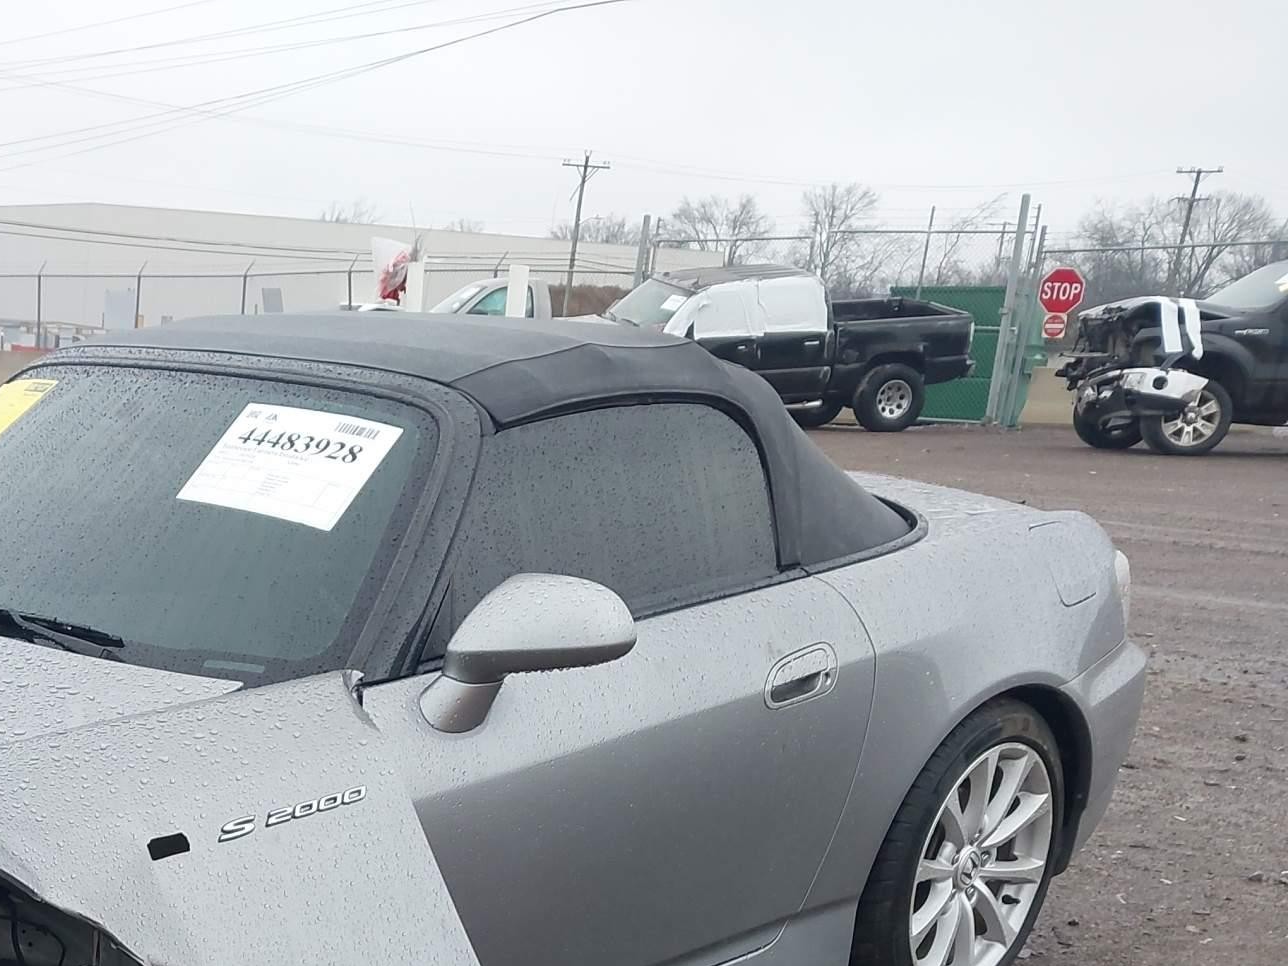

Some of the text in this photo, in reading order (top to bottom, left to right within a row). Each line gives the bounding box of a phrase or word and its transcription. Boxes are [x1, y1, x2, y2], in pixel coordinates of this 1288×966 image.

[1042, 282, 1081, 300] STOP
[238, 427, 364, 464] 44483928
[217, 785, 367, 843] S 2000
